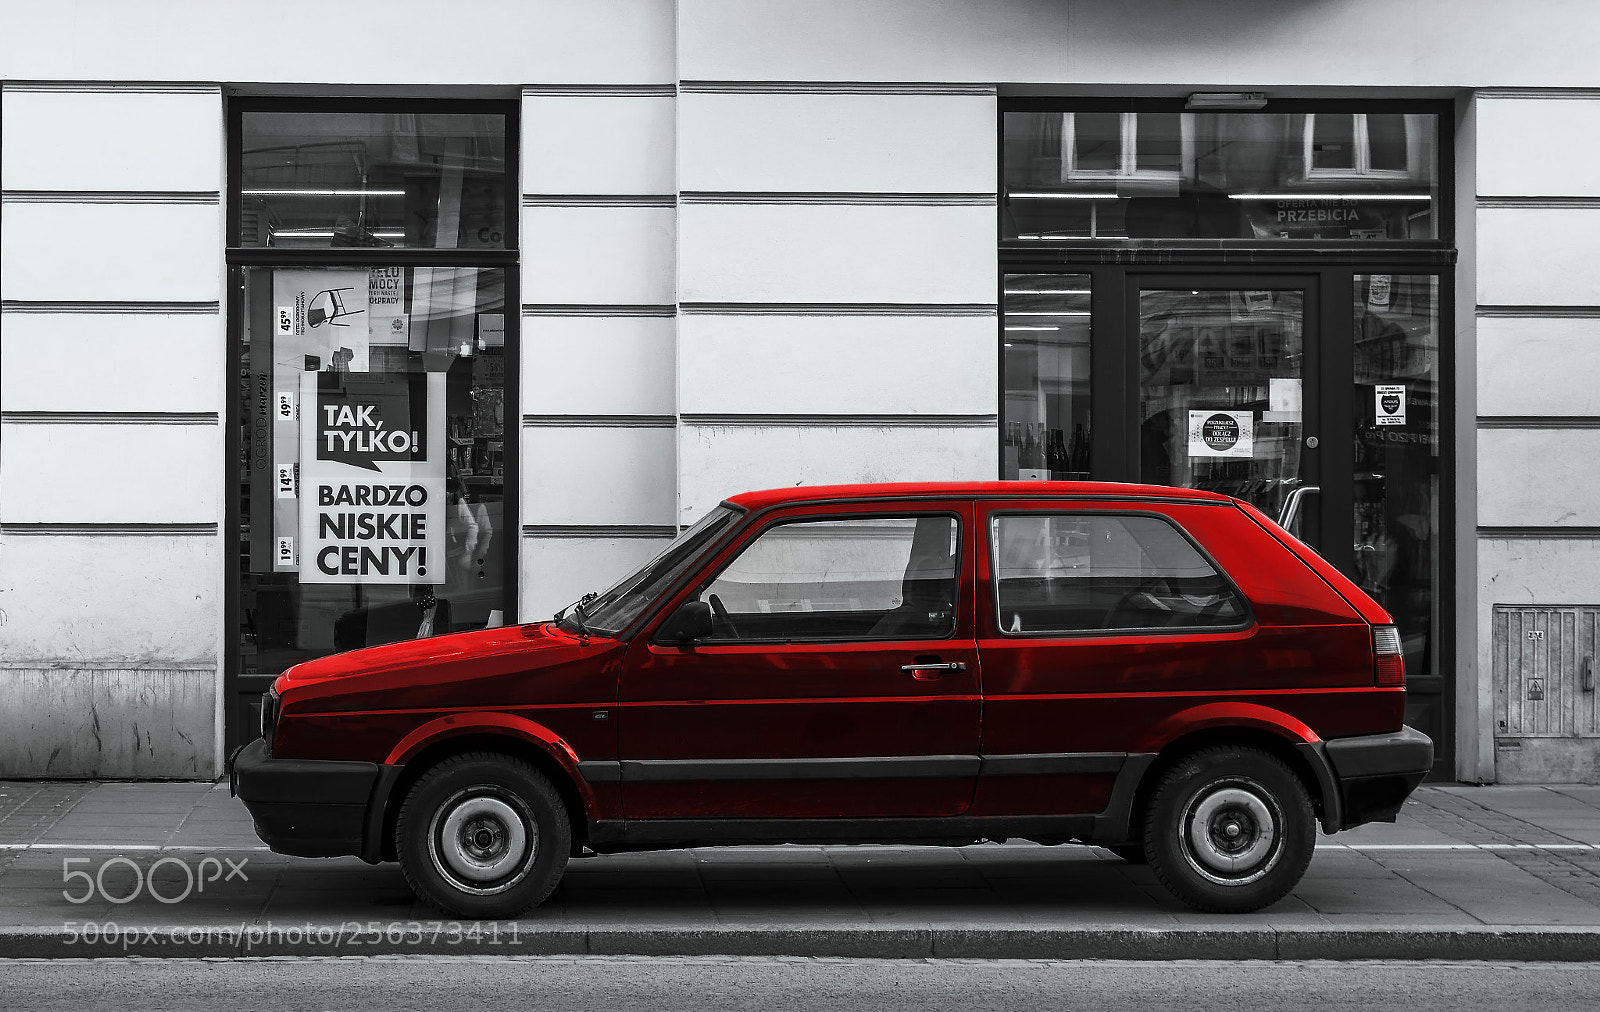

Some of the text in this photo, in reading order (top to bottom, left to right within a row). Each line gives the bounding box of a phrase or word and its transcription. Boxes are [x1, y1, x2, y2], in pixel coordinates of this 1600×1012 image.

[1277, 199, 1317, 209] OFERTA
[1320, 199, 1338, 208] NIE
[1277, 208, 1360, 223] PRZEBICIA
[256, 373, 268, 416] marzeń
[323, 404, 384, 431] TAK,
[323, 430, 420, 453] TYLKO!
[318, 484, 428, 507] BARDZO
[318, 512, 427, 540] NISKIE
[316, 545, 428, 578] CENY!
